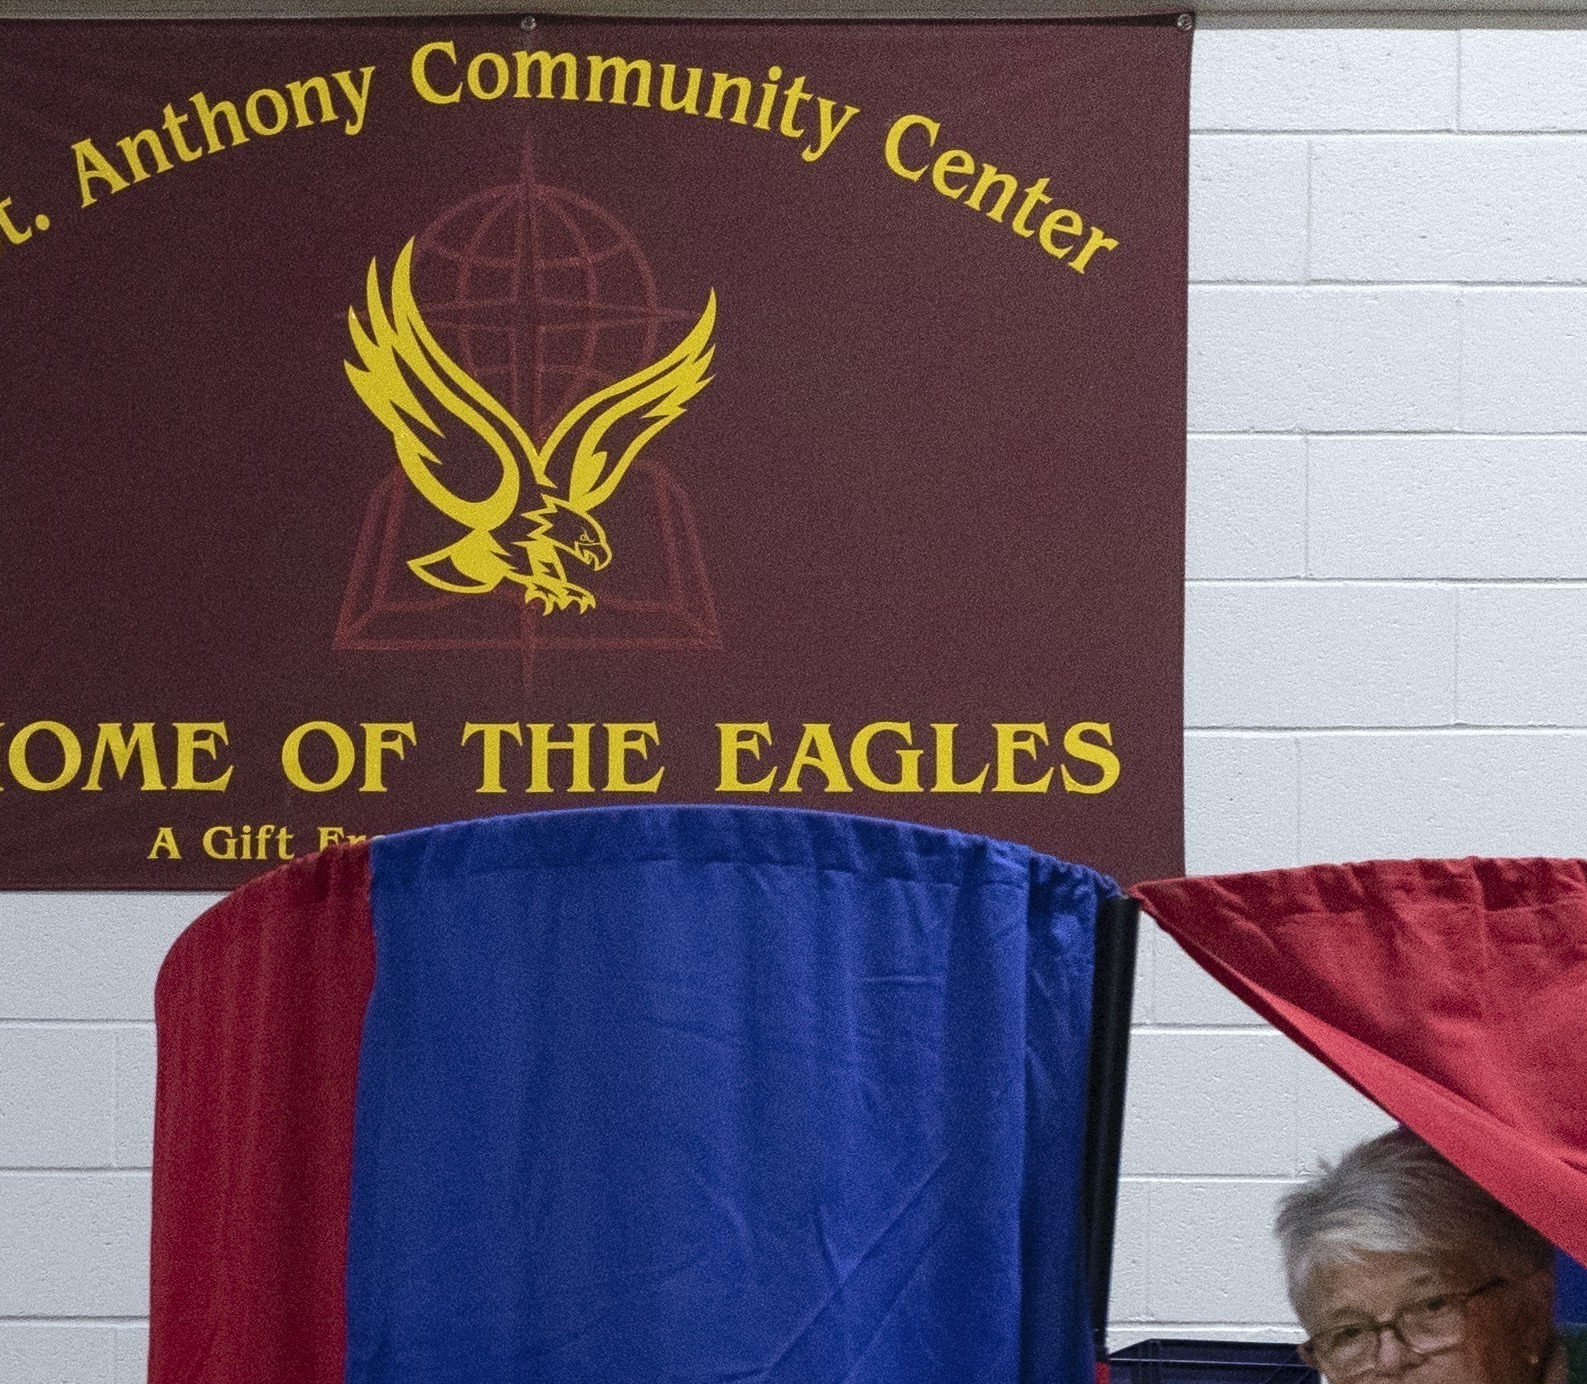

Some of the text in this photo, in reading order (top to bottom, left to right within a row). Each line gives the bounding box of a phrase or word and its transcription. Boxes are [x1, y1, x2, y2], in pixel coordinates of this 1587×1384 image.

[71, 64, 376, 209] Anthony
[410, 39, 862, 163] Community
[884, 114, 1120, 274] Center
[280, 720, 418, 794] OF
[460, 720, 666, 795] THE
[714, 720, 1122, 796] EAGLES
[147, 824, 386, 860] A Gift Fr
